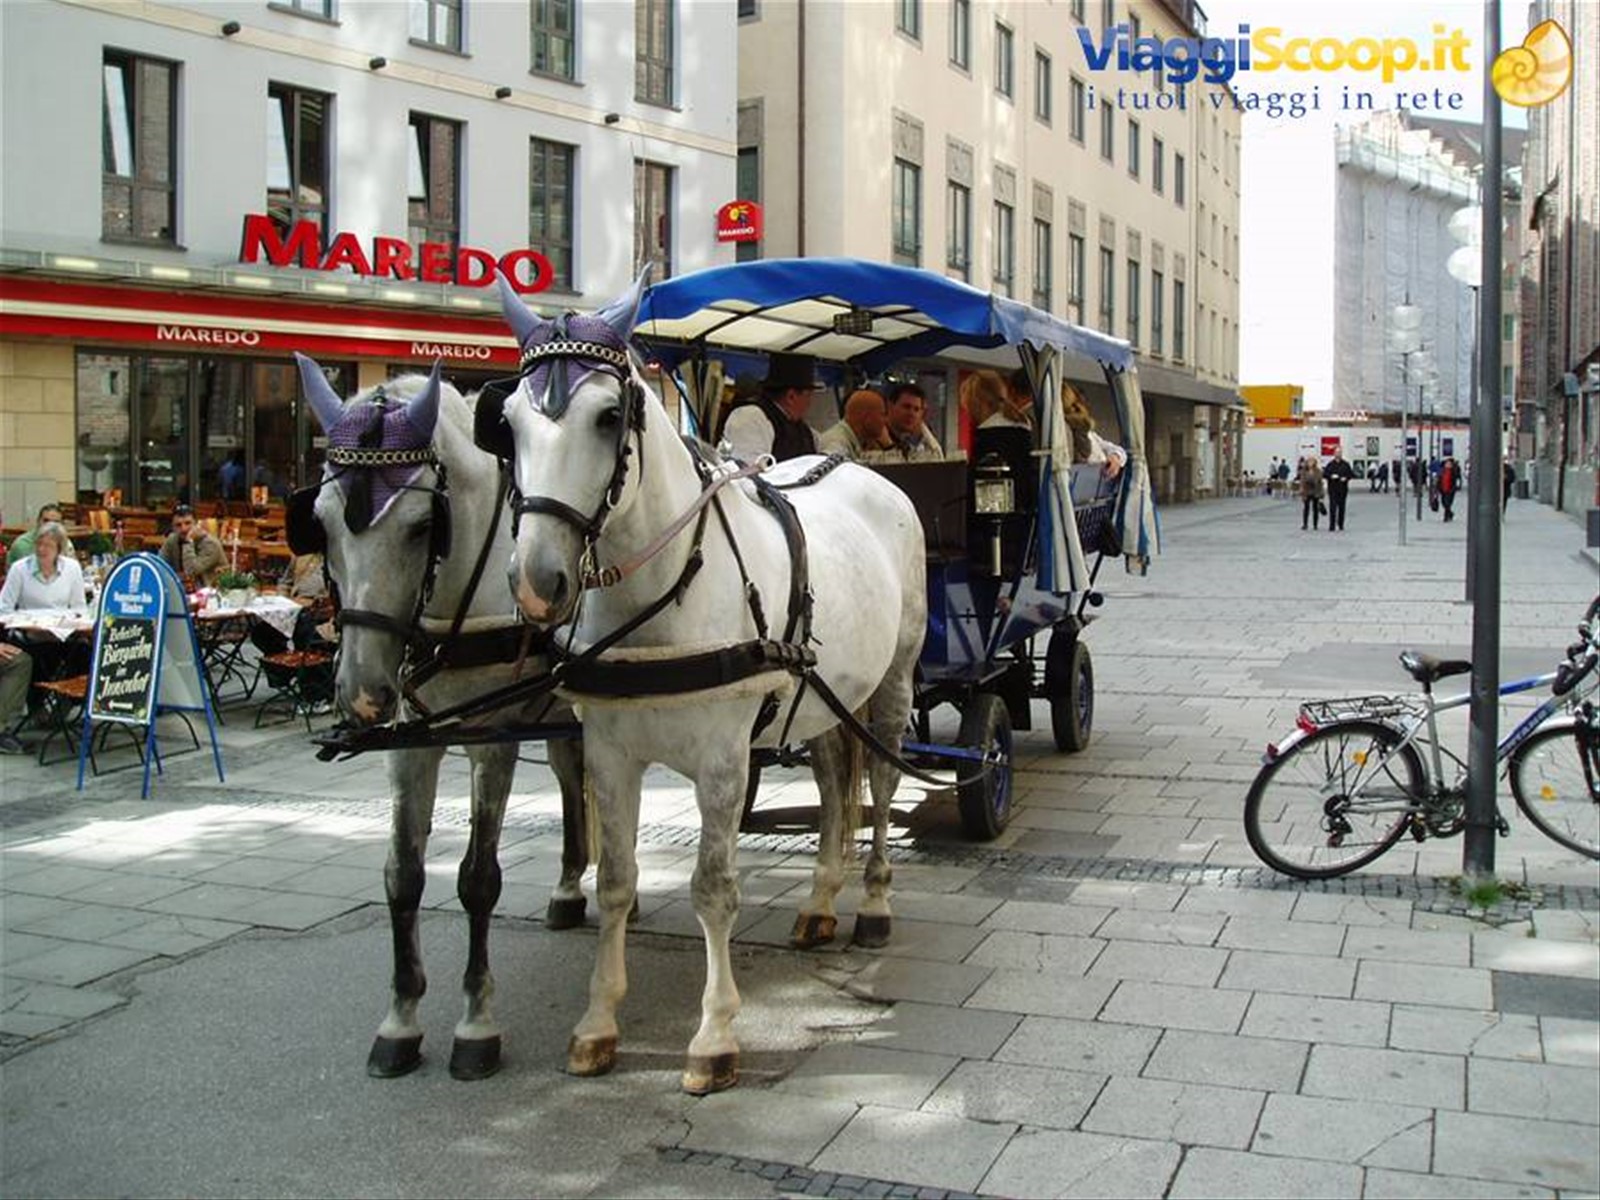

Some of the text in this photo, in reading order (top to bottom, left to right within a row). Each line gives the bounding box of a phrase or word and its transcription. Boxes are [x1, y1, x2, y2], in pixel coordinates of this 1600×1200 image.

[239, 213, 555, 295] MAREDO
[156, 325, 261, 346] MAREDO
[410, 341, 492, 360] MAREDO
